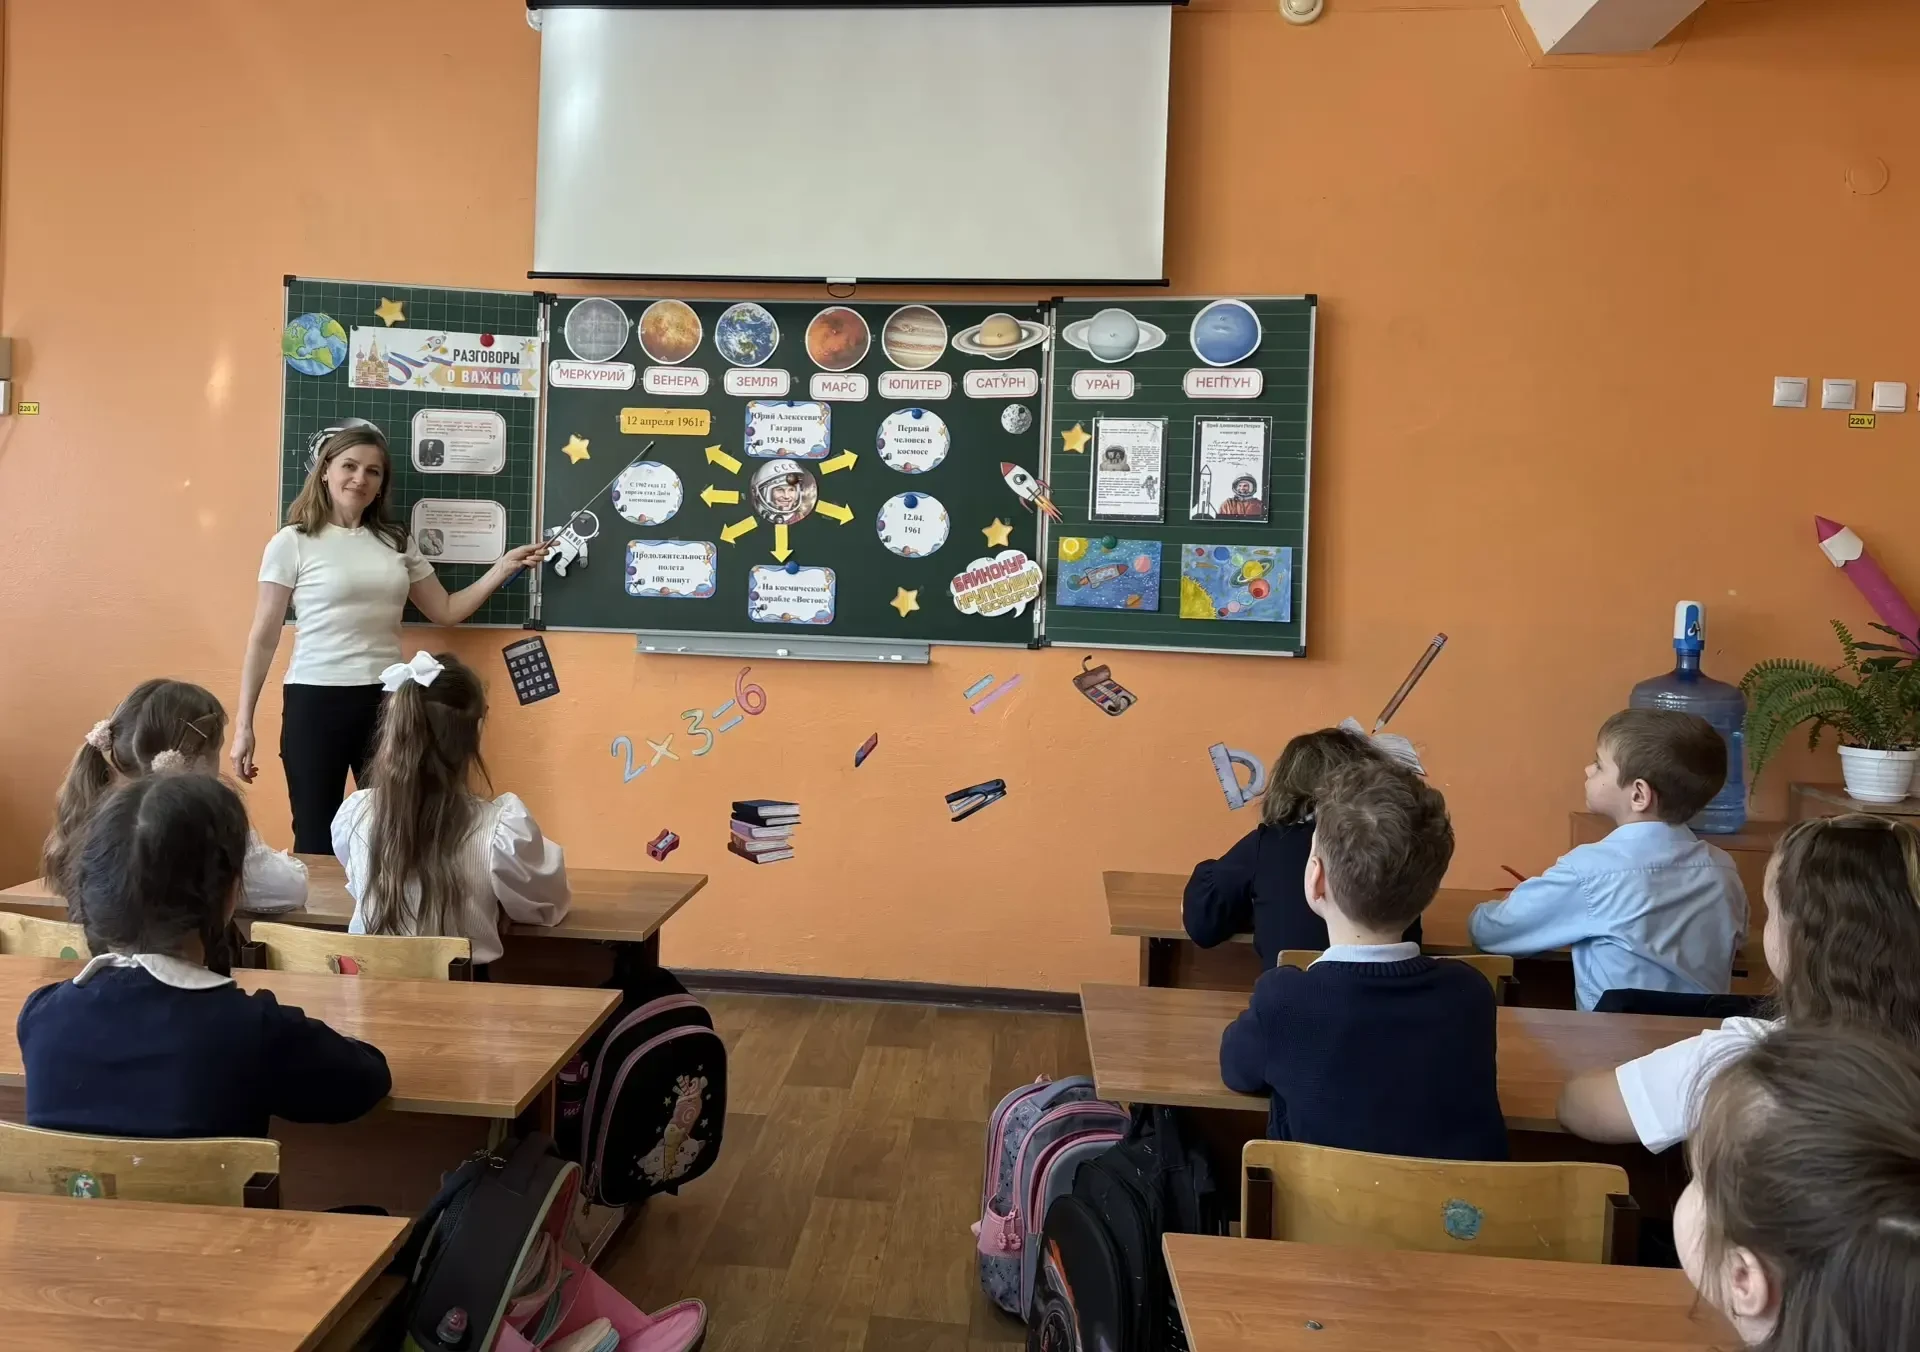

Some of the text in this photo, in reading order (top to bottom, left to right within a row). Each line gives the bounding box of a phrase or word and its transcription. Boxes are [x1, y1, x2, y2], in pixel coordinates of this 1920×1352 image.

[453, 349, 520, 365] РАЗГОВОРЫ
[447, 369, 523, 386] О ВАЖНОМ
[559, 369, 625, 381] МЕРКУРИЙ
[653, 375, 699, 386] ВЕНЕРА
[736, 376, 778, 387] ЗЕМЛЯ
[889, 379, 942, 390] ЮПИТЕР
[976, 377, 1026, 389] САТУРН
[1086, 379, 1120, 390] УРАН
[1196, 377, 1250, 388] НЕПТУН
[821, 382, 857, 393] МАРС
[627, 416, 704, 428] 12 апреля 1961г
[751, 412, 822, 422] Юрий Алексеевич
[770, 424, 803, 433] Гагарин
[897, 424, 930, 433] Первый
[766, 436, 784, 444] 1934
[903, 513, 925, 522] 12.04.
[904, 526, 921, 534] 1961
[952, 553, 1026, 593] БАЙКОНУР
[652, 575, 690, 585] 108 минут
[762, 583, 773, 591] На
[759, 595, 827, 604] корабле «Восток»
